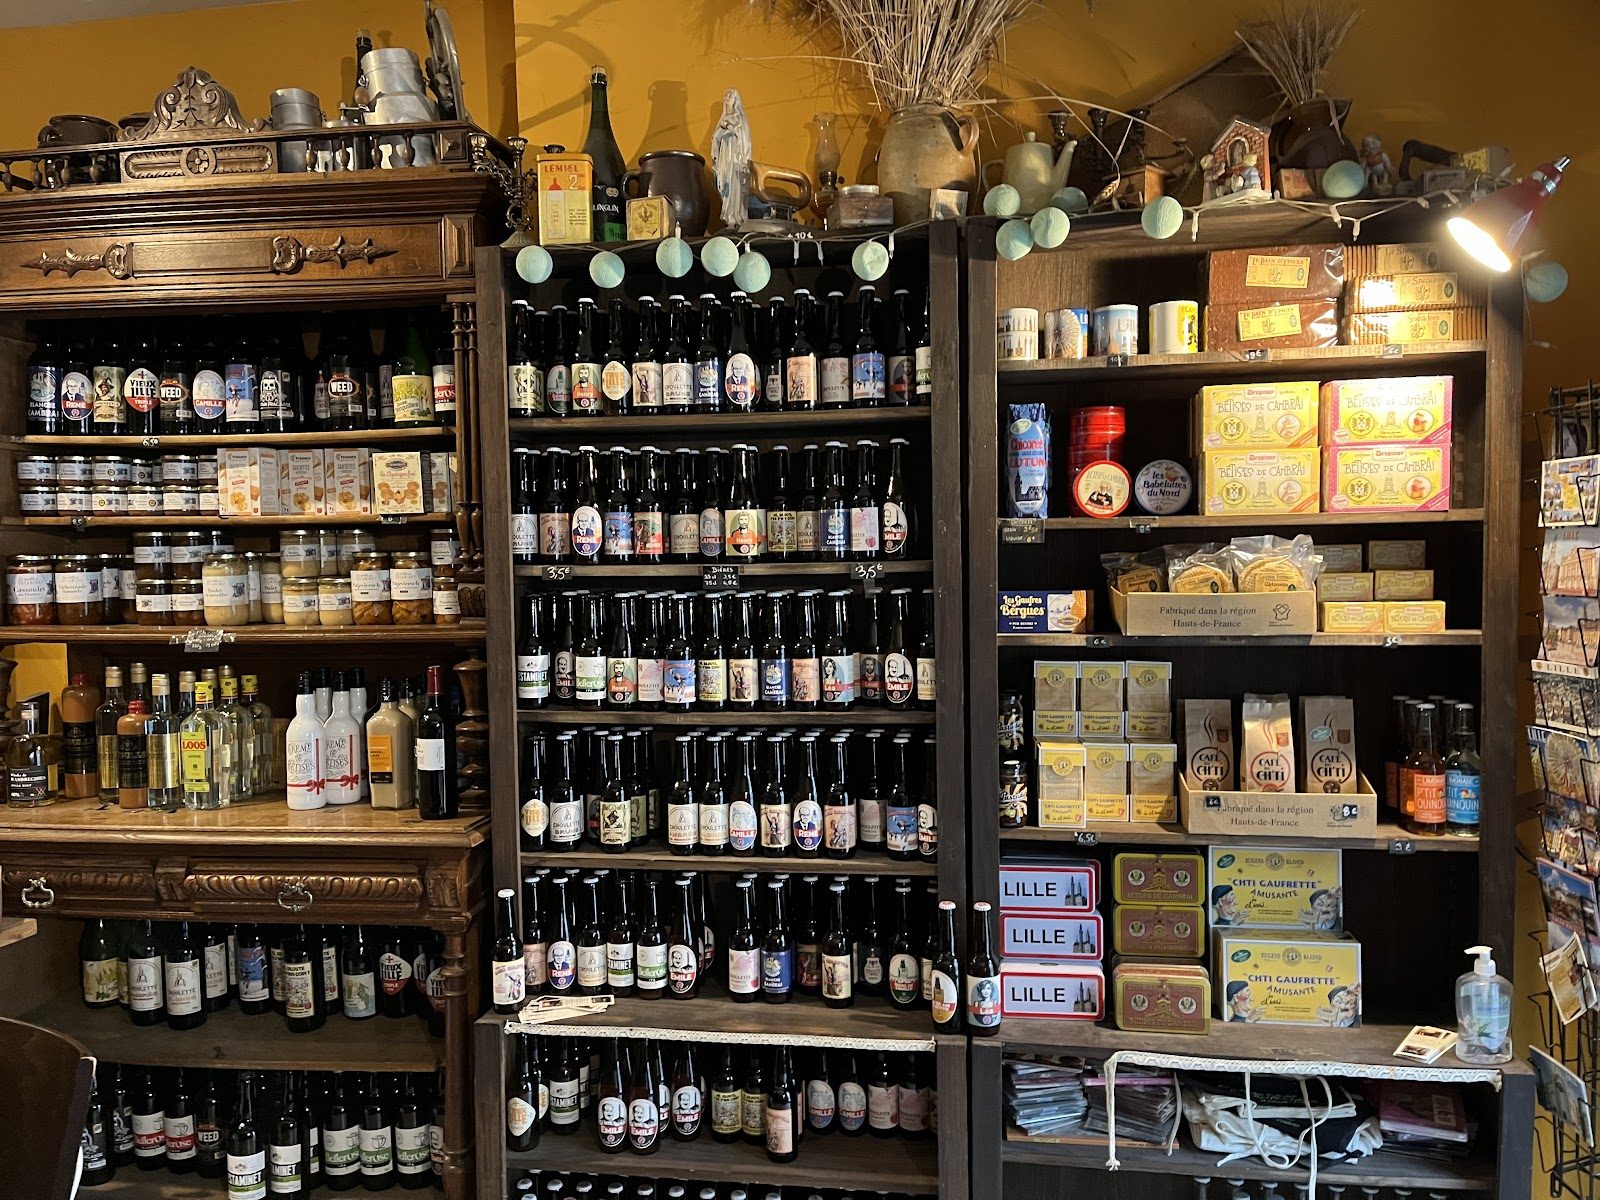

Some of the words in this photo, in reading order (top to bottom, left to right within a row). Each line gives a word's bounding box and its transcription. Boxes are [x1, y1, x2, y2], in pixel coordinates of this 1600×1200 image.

[331, 382, 352, 393] WEED
[1143, 481, 1187, 489] Babeluttes
[1159, 489, 1180, 497] Nord
[1003, 595, 1015, 604] Les
[1015, 595, 1042, 607] Gaufres
[1000, 605, 1045, 619] Bergues
[1160, 606, 1196, 616] Fabriqué
[1199, 607, 1216, 615] dans
[1219, 606, 1228, 614] la
[1230, 606, 1256, 617] région
[1173, 619, 1241, 628] Hauts-de-France
[182, 741, 206, 750] LOOS
[1288, 806, 1313, 814] région
[1231, 818, 1299, 826] Hauts-de-France
[1004, 882, 1057, 897] LILLE
[1251, 889, 1299, 899] AMUSANTE
[1013, 928, 1066, 943] LILLE
[381, 963, 401, 971] VIEUX
[1011, 987, 1066, 1002] LILLE
[1267, 985, 1317, 995] AMUSANTE
